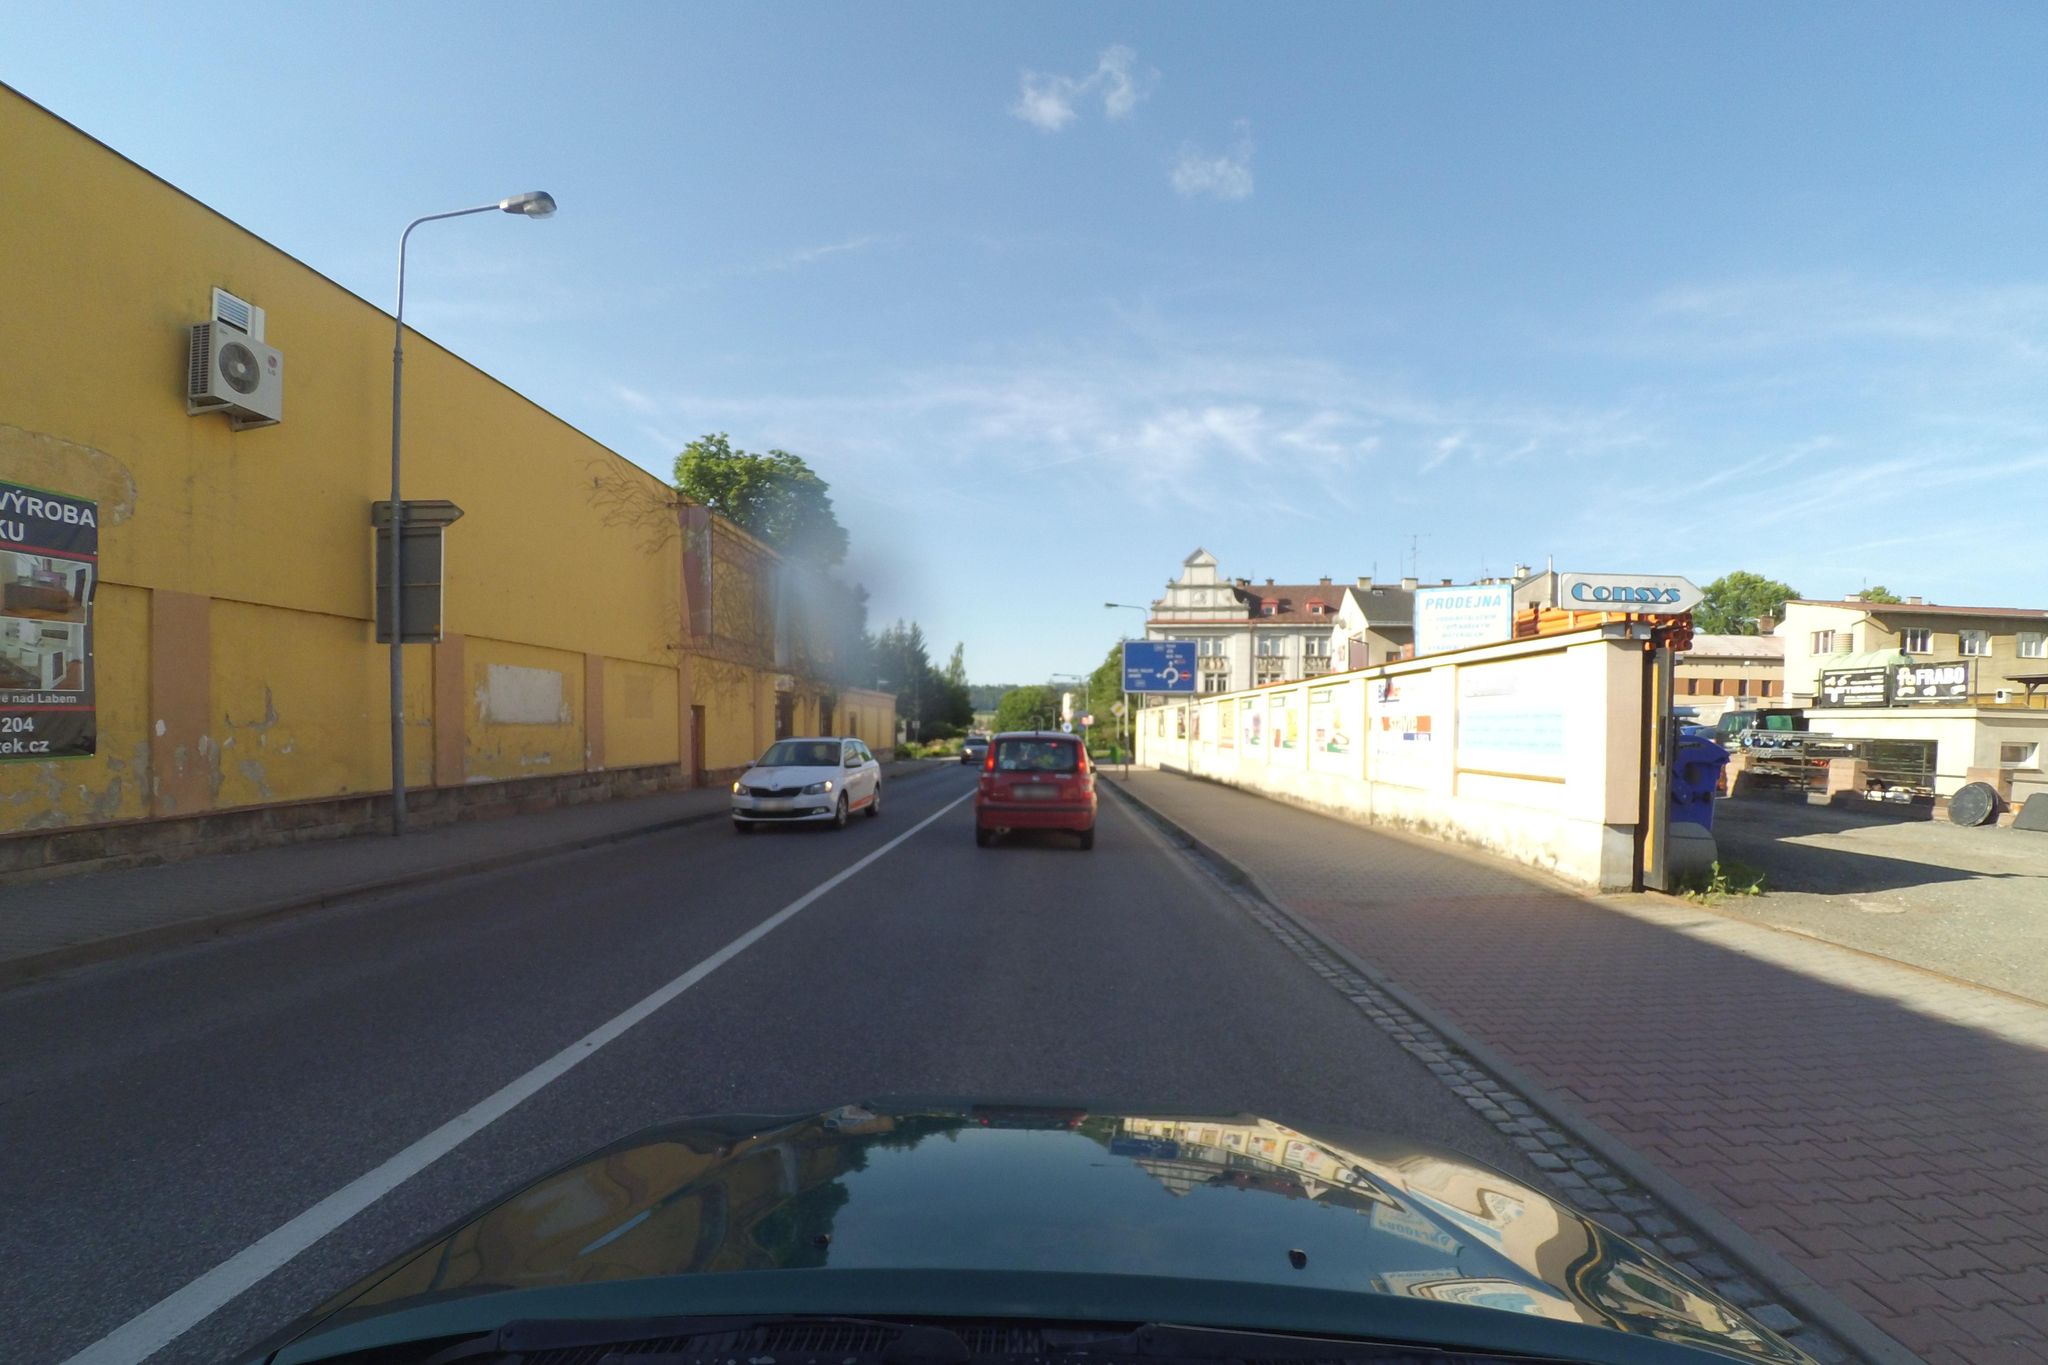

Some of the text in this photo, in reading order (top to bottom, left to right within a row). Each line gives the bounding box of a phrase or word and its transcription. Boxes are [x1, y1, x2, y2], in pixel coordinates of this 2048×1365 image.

[0, 490, 96, 528] VÝROBA
[1571, 582, 1681, 604] Consys
[1425, 594, 1502, 610] PRODEJNA
[12, 693, 34, 703] nad
[37, 693, 77, 704] Labem
[1, 716, 35, 733] 204
[0, 738, 50, 754] ek.cz
